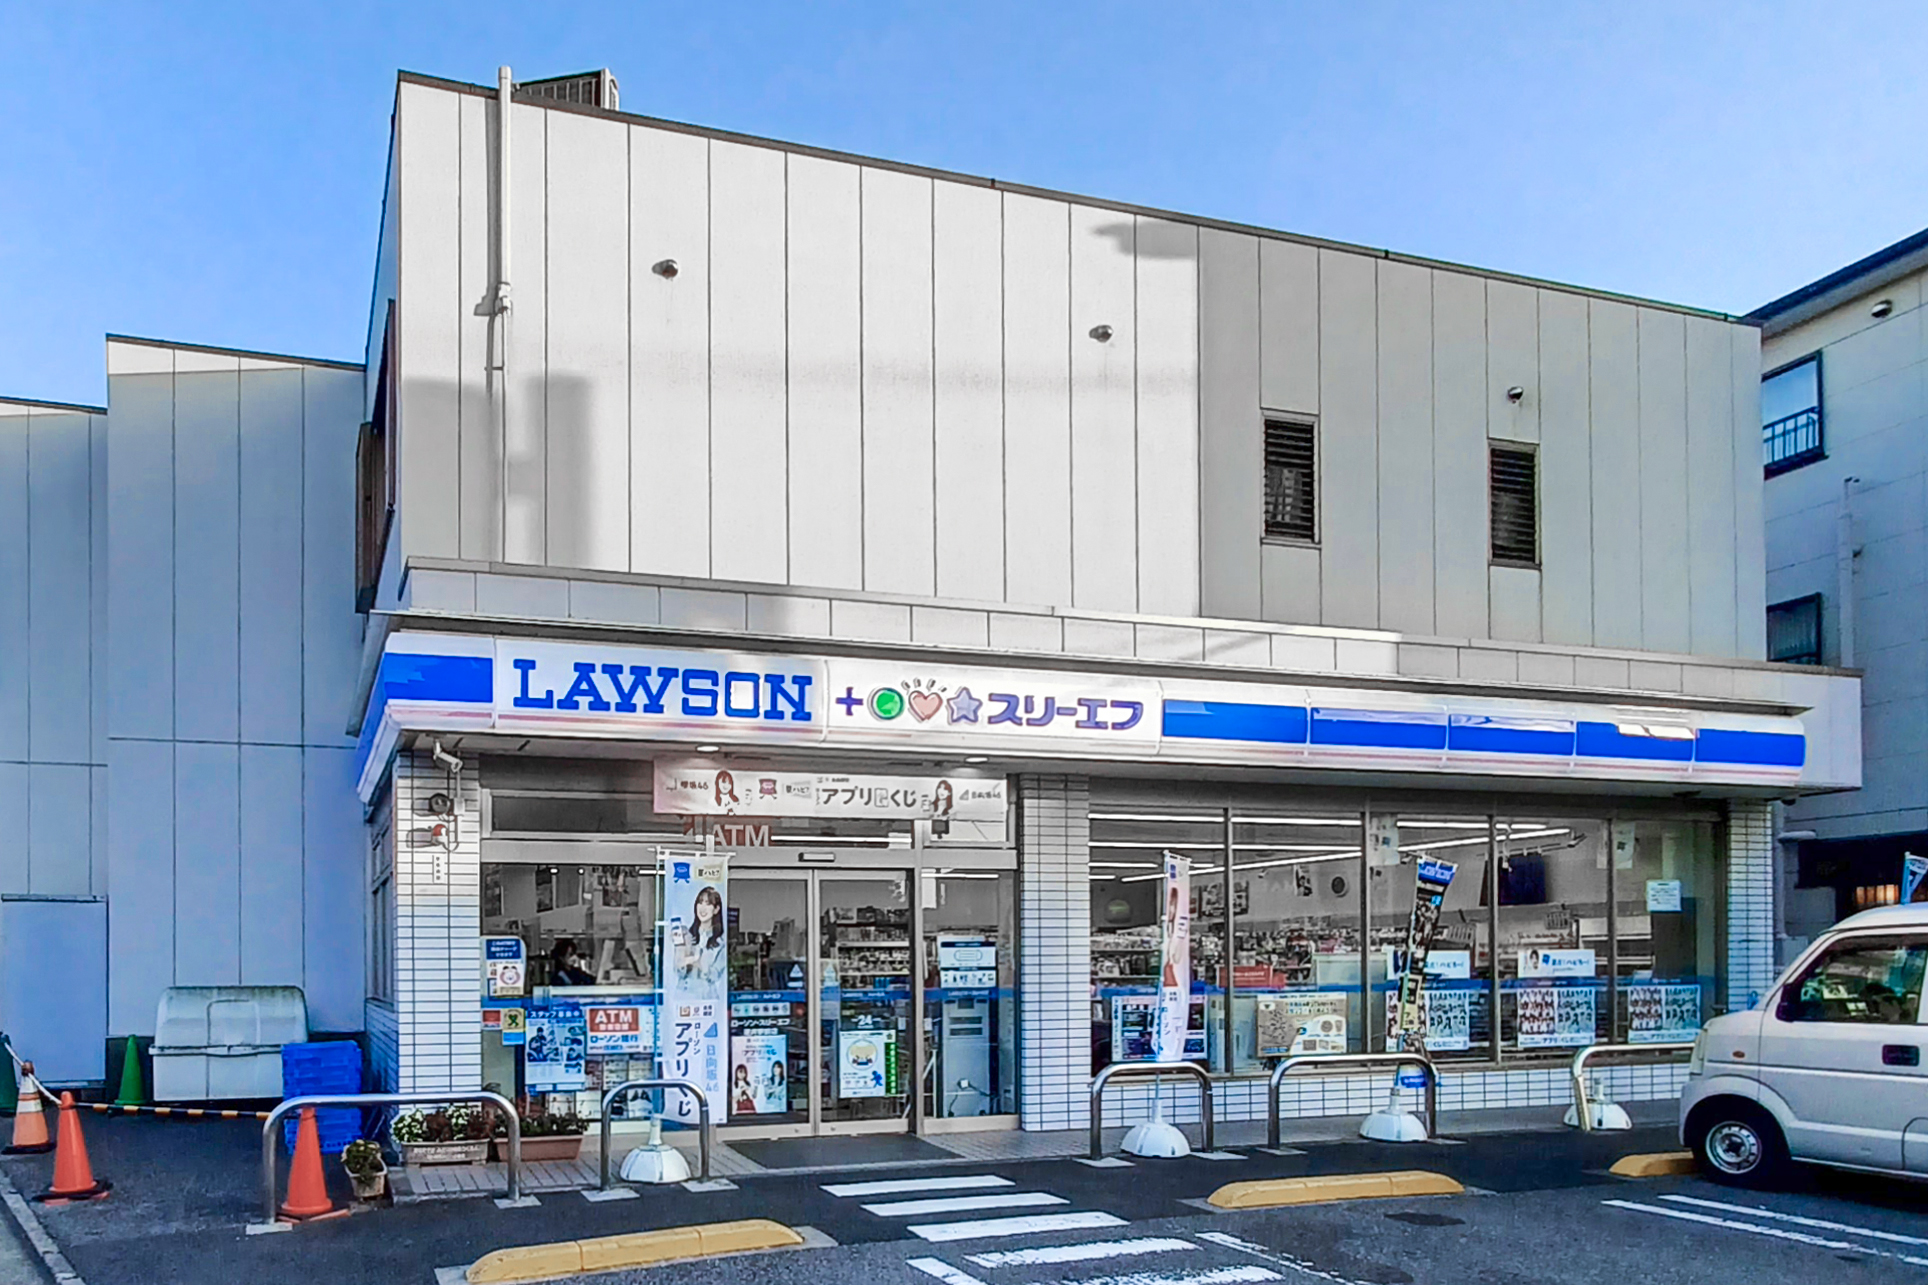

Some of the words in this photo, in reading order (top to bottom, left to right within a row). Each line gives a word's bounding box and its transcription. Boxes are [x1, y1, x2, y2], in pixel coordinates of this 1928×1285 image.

[513, 658, 813, 722] LAWSON
[987, 691, 1144, 731] スリーエフ
[713, 824, 770, 848] ATM
[595, 1009, 633, 1024] ATM
[693, 1022, 701, 1056] ローソン
